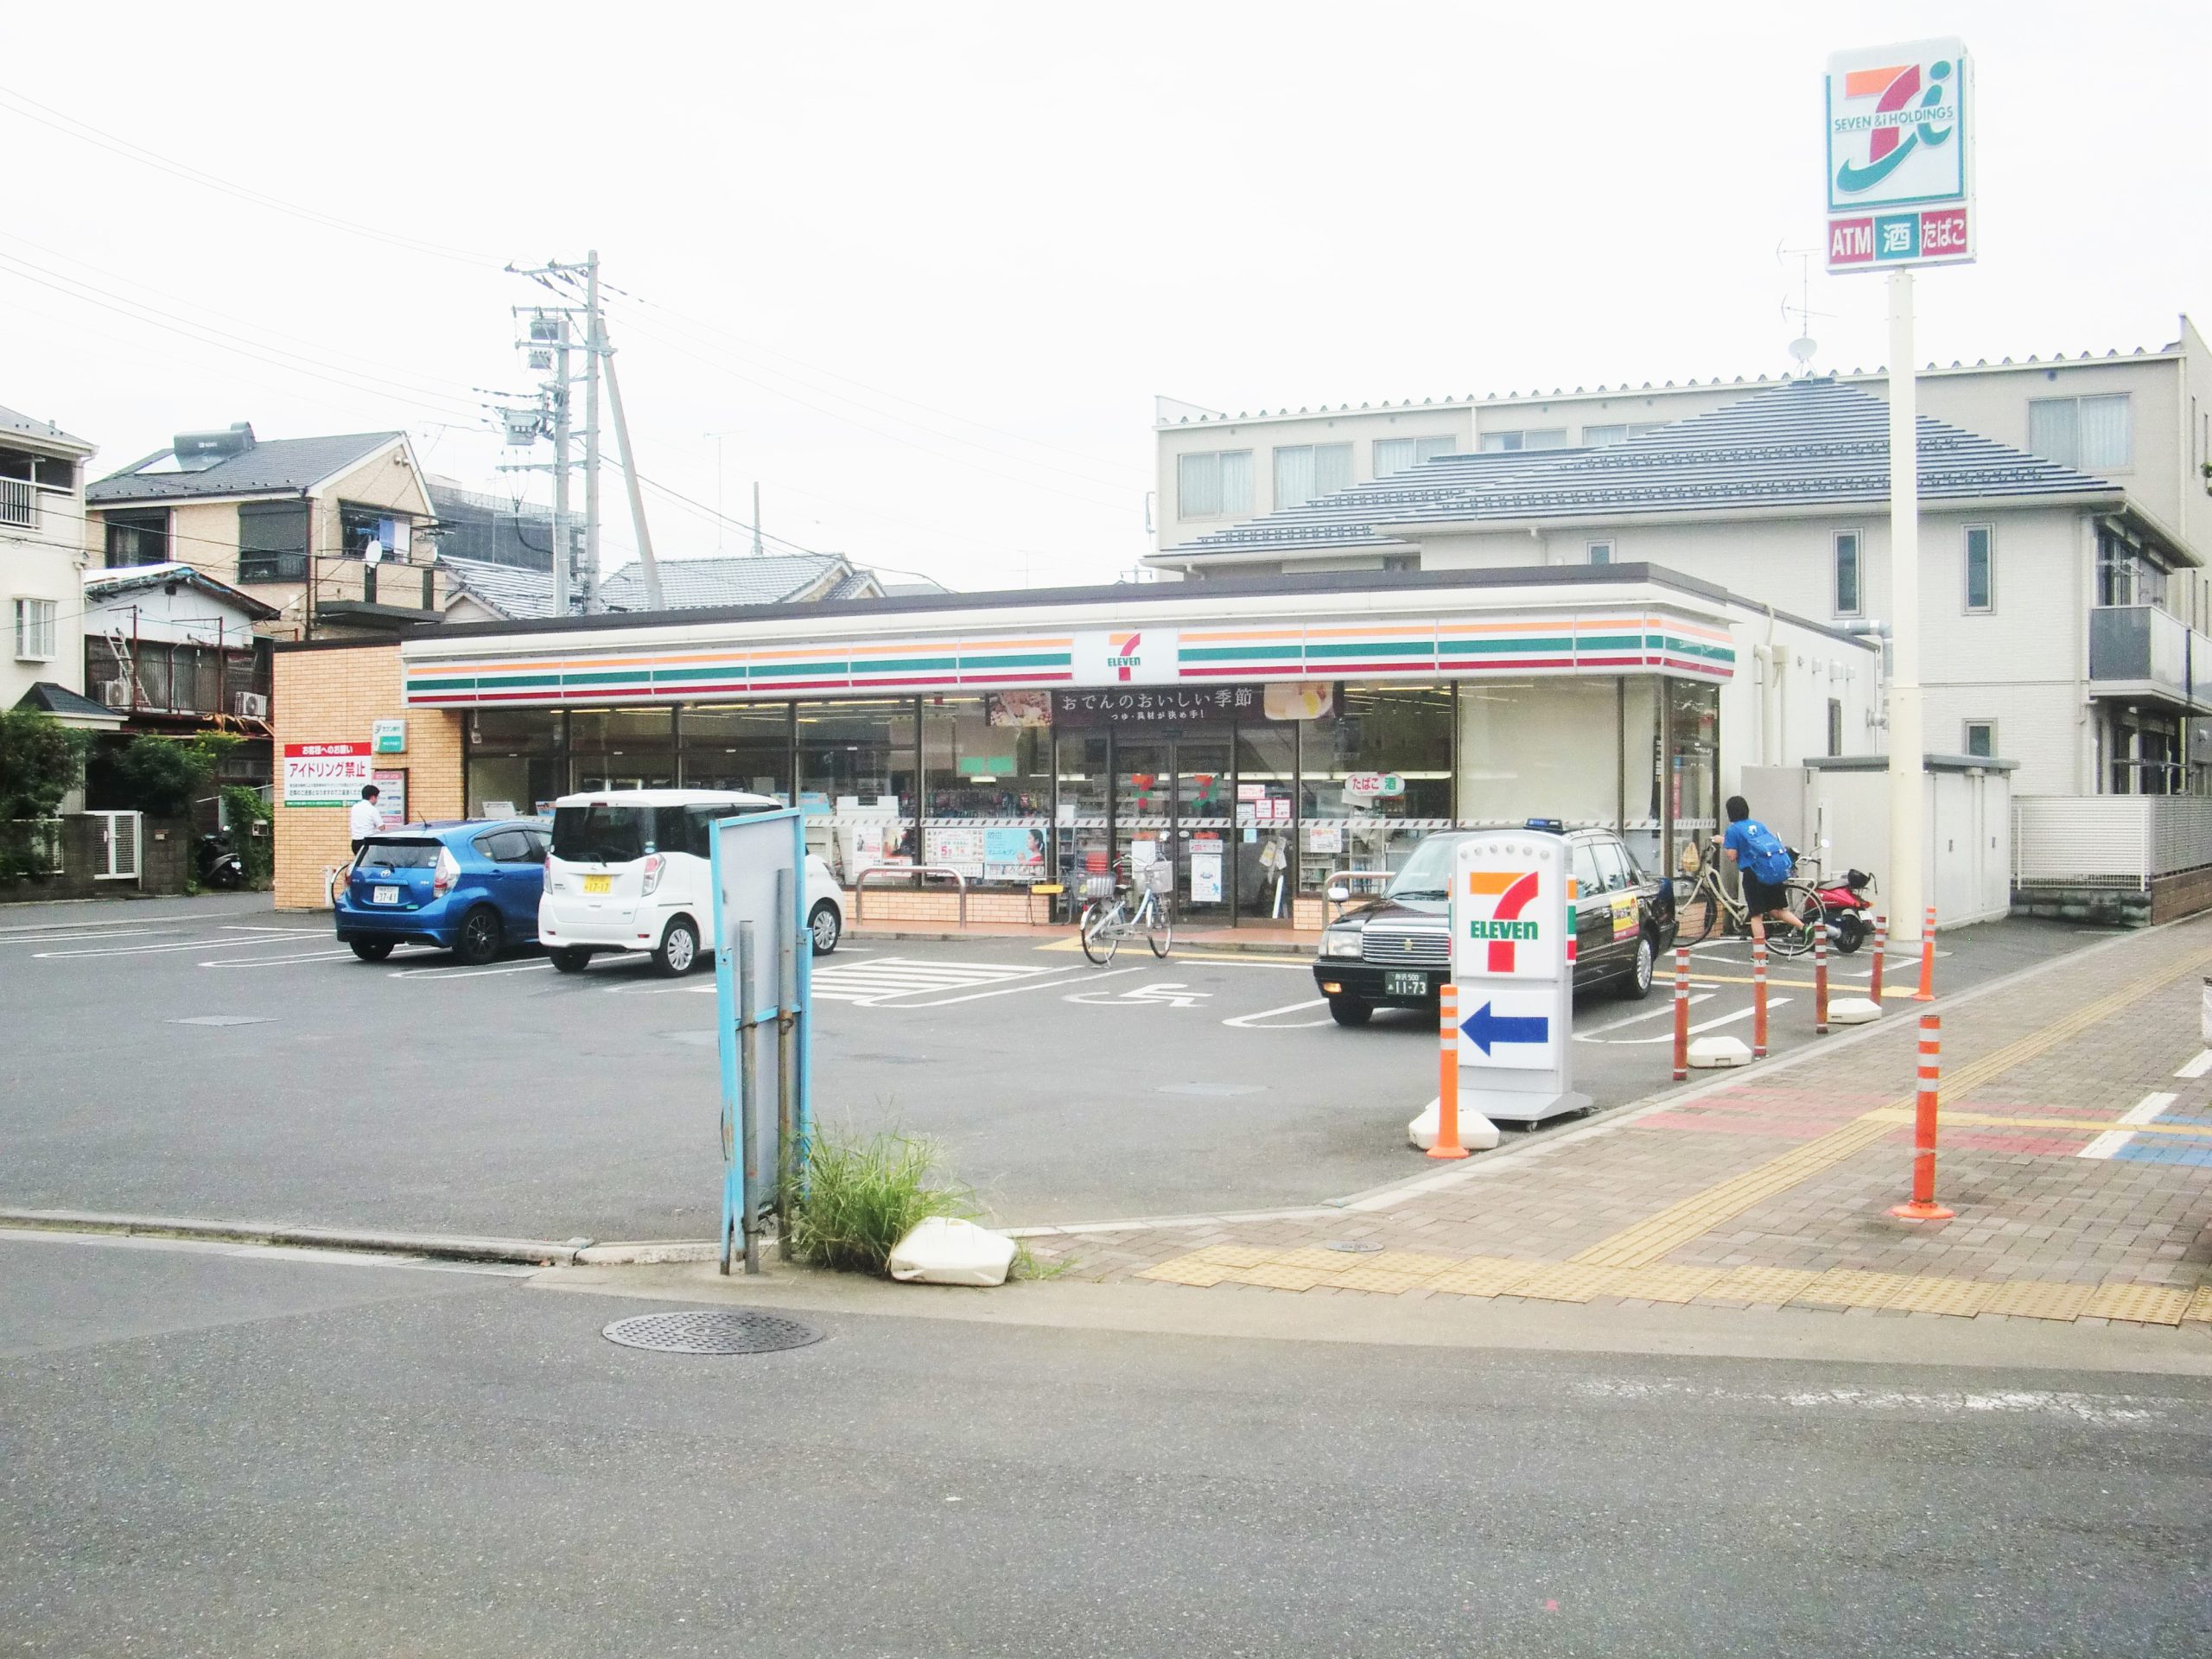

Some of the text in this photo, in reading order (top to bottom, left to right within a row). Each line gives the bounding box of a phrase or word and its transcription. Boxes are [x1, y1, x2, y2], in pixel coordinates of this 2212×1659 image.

[1834, 116, 1872, 131] SEVEN
[1889, 105, 1954, 126] HOLDINGS
[1831, 226, 1872, 257] ATM
[1883, 222, 1911, 253] 酒
[1923, 218, 1967, 250] たばこ
[1062, 688, 1253, 711] おでんのおいしい季節
[289, 761, 366, 778] アイドリング禁止
[1352, 777, 1380, 791] たばこ
[1395, 981, 1426, 995] 11-73
